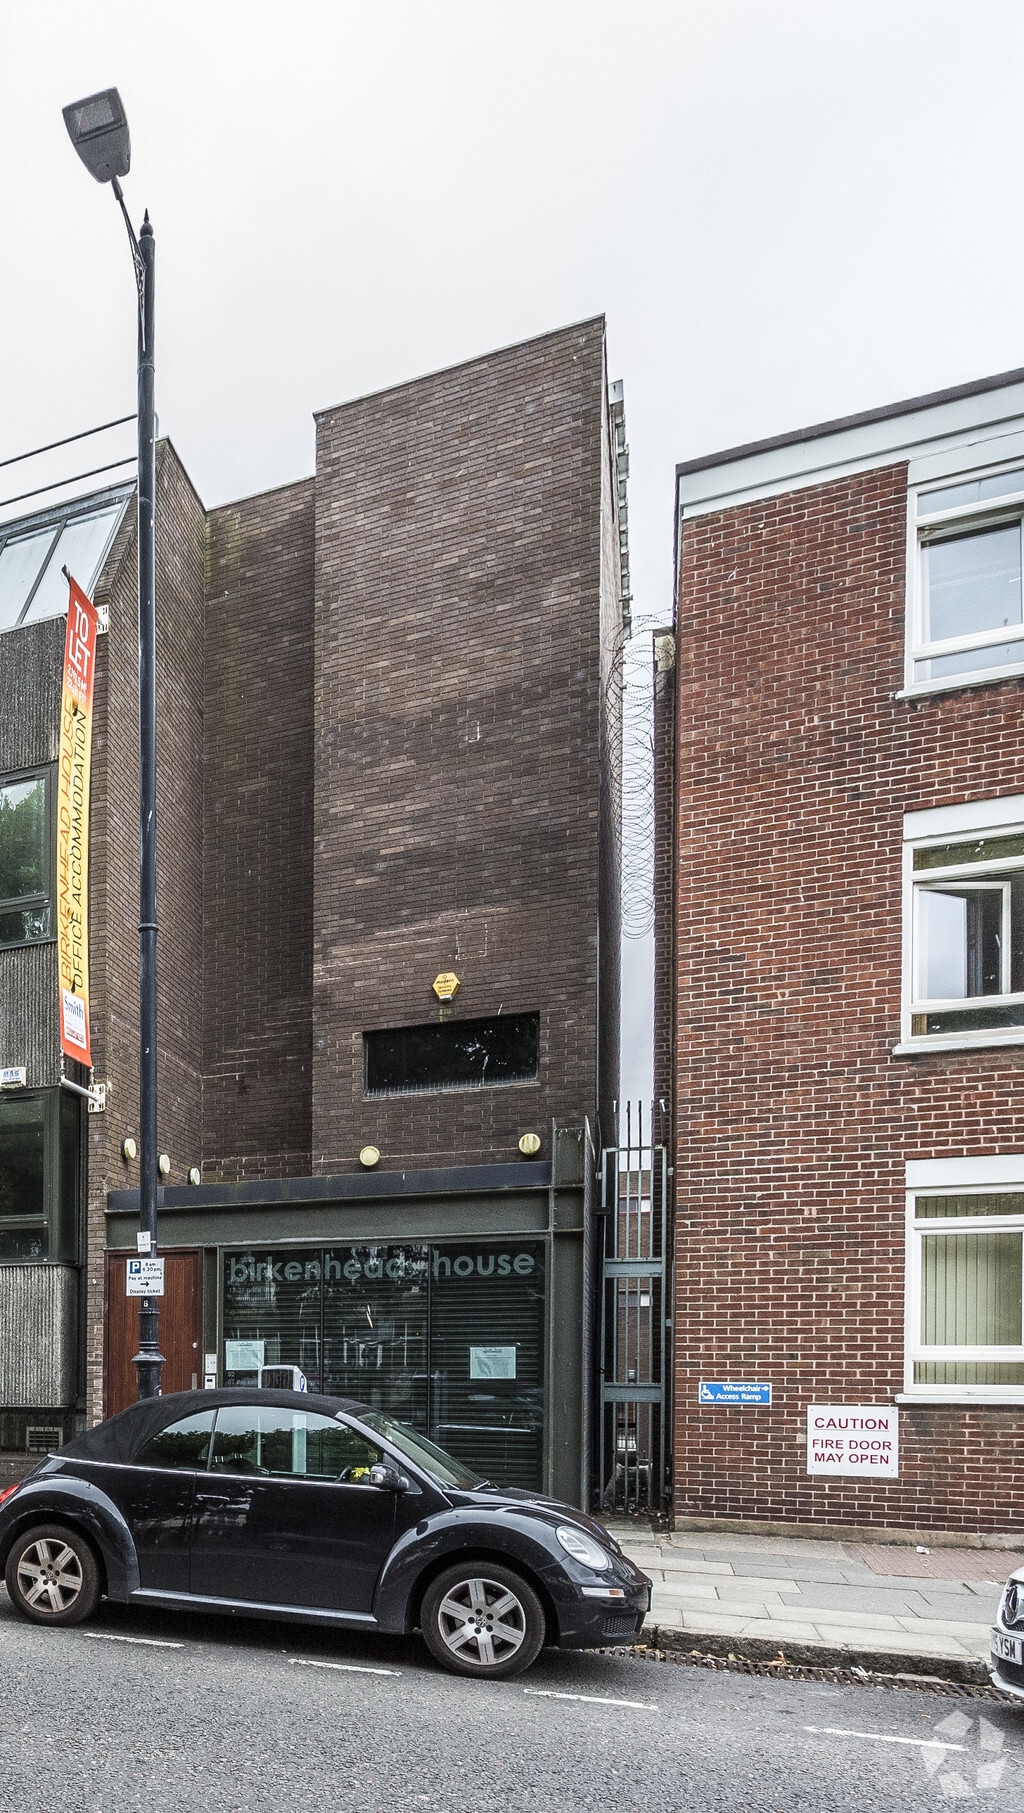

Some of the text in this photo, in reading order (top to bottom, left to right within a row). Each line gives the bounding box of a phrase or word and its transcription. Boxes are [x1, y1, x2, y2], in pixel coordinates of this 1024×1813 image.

[74, 600, 89, 643] TO
[68, 629, 91, 677] LET
[72, 709, 87, 907] ACCOMMODATION
[59, 694, 74, 983] BIRKENHEAD HOUSE
[72, 911, 83, 988] OFFICE
[230, 1250, 535, 1282] birkenhead house
[741, 1393, 762, 1401] Ramp
[814, 1417, 889, 1430] CAUTION
[812, 1439, 892, 1451] FIRE DOOR
[814, 1452, 889, 1464] MAY OPEN
[999, 1636, 1016, 1659] YSM
